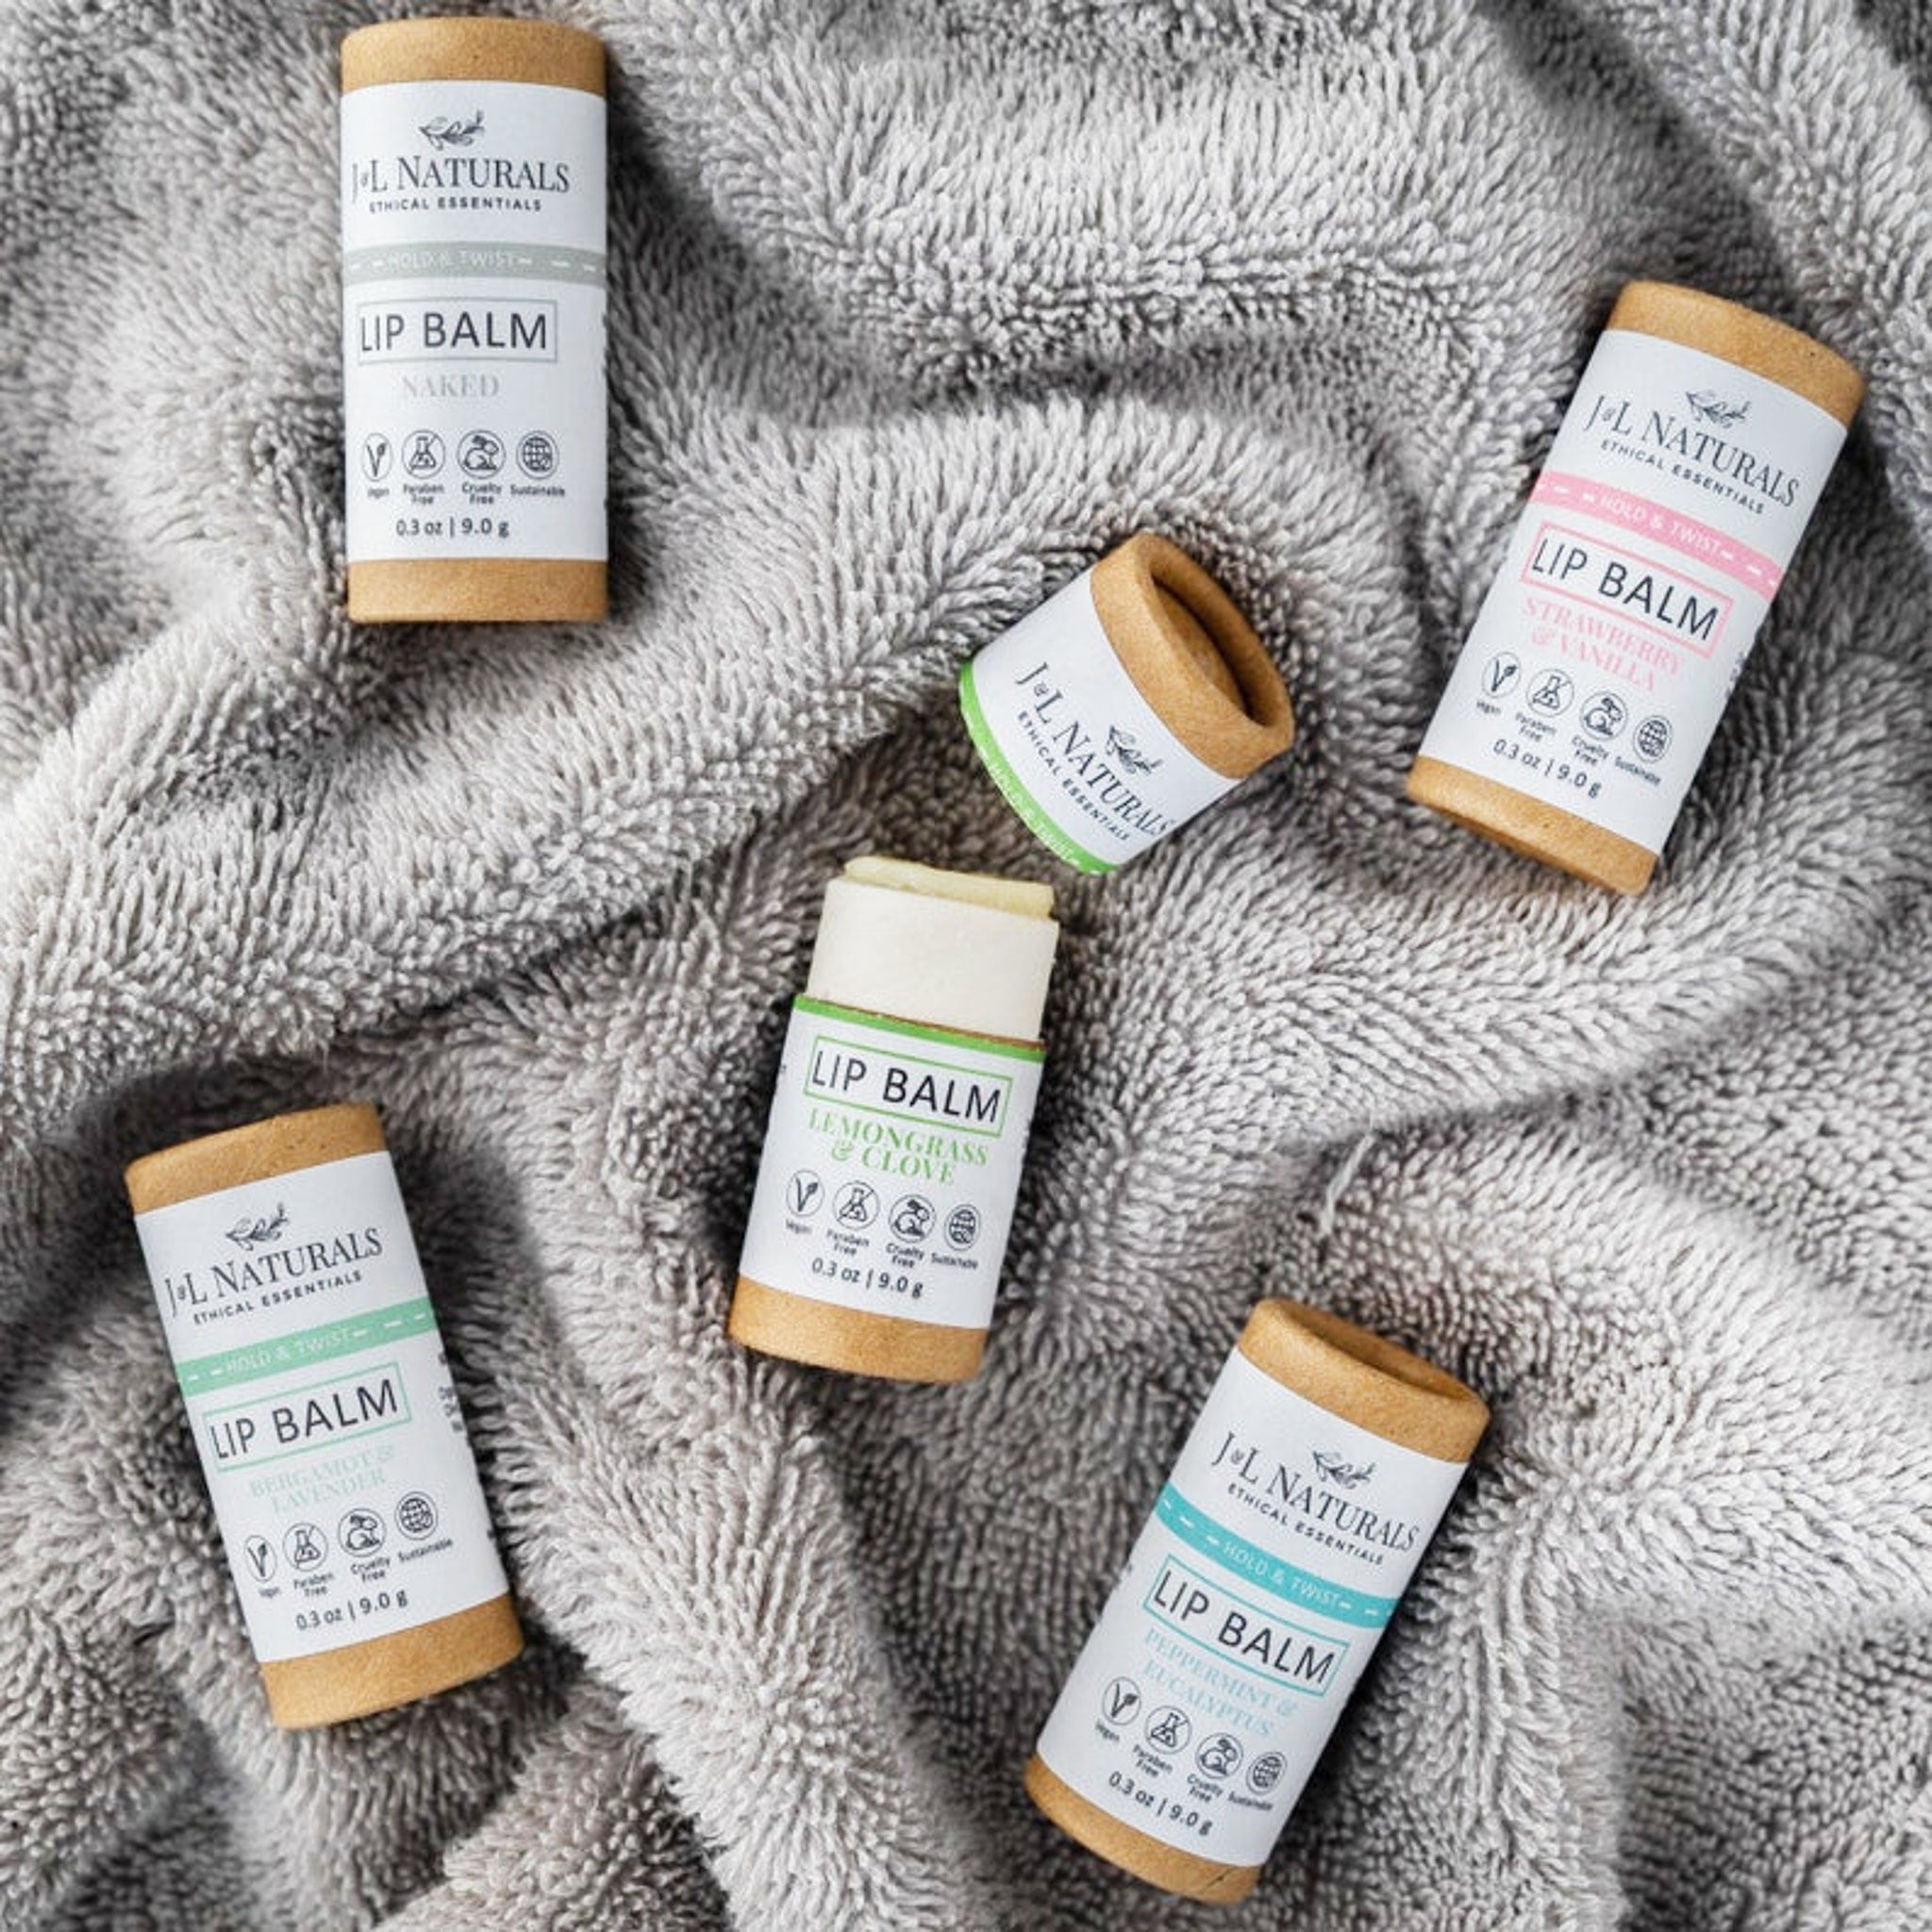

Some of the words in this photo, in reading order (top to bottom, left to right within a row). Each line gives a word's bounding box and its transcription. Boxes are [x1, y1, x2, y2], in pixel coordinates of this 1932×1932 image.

[369, 197, 429, 212] ETHICAL
[438, 196, 541, 212] ESSENTIALS
[397, 156, 570, 193] NATURALS
[360, 314, 405, 351] LIP
[425, 311, 546, 349] BALM
[401, 375, 500, 397] NAKED
[1600, 440, 1665, 470] ETHICAL
[1672, 463, 1765, 515] ESSENTIALS
[1641, 409, 1801, 508] NATURALS
[396, 519, 419, 536] 0.3
[425, 522, 442, 535] oz
[461, 518, 492, 534] 9.0
[498, 520, 509, 538] g
[1599, 495, 1647, 523] HOLD
[1670, 519, 1721, 554] TWIST
[1530, 539, 1589, 580] LIP
[1598, 561, 1720, 641] BALM
[1525, 597, 1685, 676] STRAWBERRY
[1556, 633, 1657, 692] VANILLA
[1017, 710, 1062, 776] ETHICAL
[1061, 777, 1132, 841] ESSENTIALS
[1492, 738, 1520, 760] 0.3
[1522, 754, 1541, 770] oz
[1557, 764, 1589, 789] 9.0
[1588, 782, 1603, 800] g
[812, 1051, 867, 1091] LIP
[882, 1067, 1001, 1124] BALM
[808, 1108, 991, 1167] LEMONGRASS
[830, 1141, 853, 1161] &
[861, 1145, 956, 1185] CLOVE
[209, 1227, 384, 1299] NATURALS
[812, 1257, 838, 1276] 0.3
[841, 1268, 860, 1283] oz
[877, 1272, 908, 1293] 9.0
[911, 1281, 924, 1300] g
[886, 1242, 925, 1261] Cruelty
[192, 1300, 255, 1324] ETHICAL
[261, 1270, 362, 1307] ESSENTIALS
[226, 1350, 272, 1372] HOLD
[294, 1327, 350, 1355] TWIST
[209, 1417, 256, 1459] LIP
[272, 1378, 398, 1444] BALM
[271, 1469, 387, 1513] LAVENDER
[1265, 1463, 1420, 1553] NATURALS
[1227, 1483, 1289, 1526] ETHICAL
[1294, 1521, 1383, 1566] ESSENTIALS
[1224, 1540, 1268, 1575] HOLD
[1291, 1576, 1341, 1606] TWIST
[295, 1609, 321, 1631] 0.3
[324, 1607, 343, 1623] oz
[359, 1591, 391, 1615] 9.0
[396, 1590, 408, 1607] g
[1153, 1570, 1210, 1622] LIP
[1217, 1610, 1335, 1685] BALM
[1142, 1658, 1274, 1738] EUCALYPTUS
[1144, 1628, 1272, 1711] PEPPERMINT
[1108, 1771, 1134, 1796] 0.3
[1136, 1790, 1156, 1810] oz
[1169, 1803, 1200, 1828] 9.0
[1198, 1819, 1214, 1837] g
